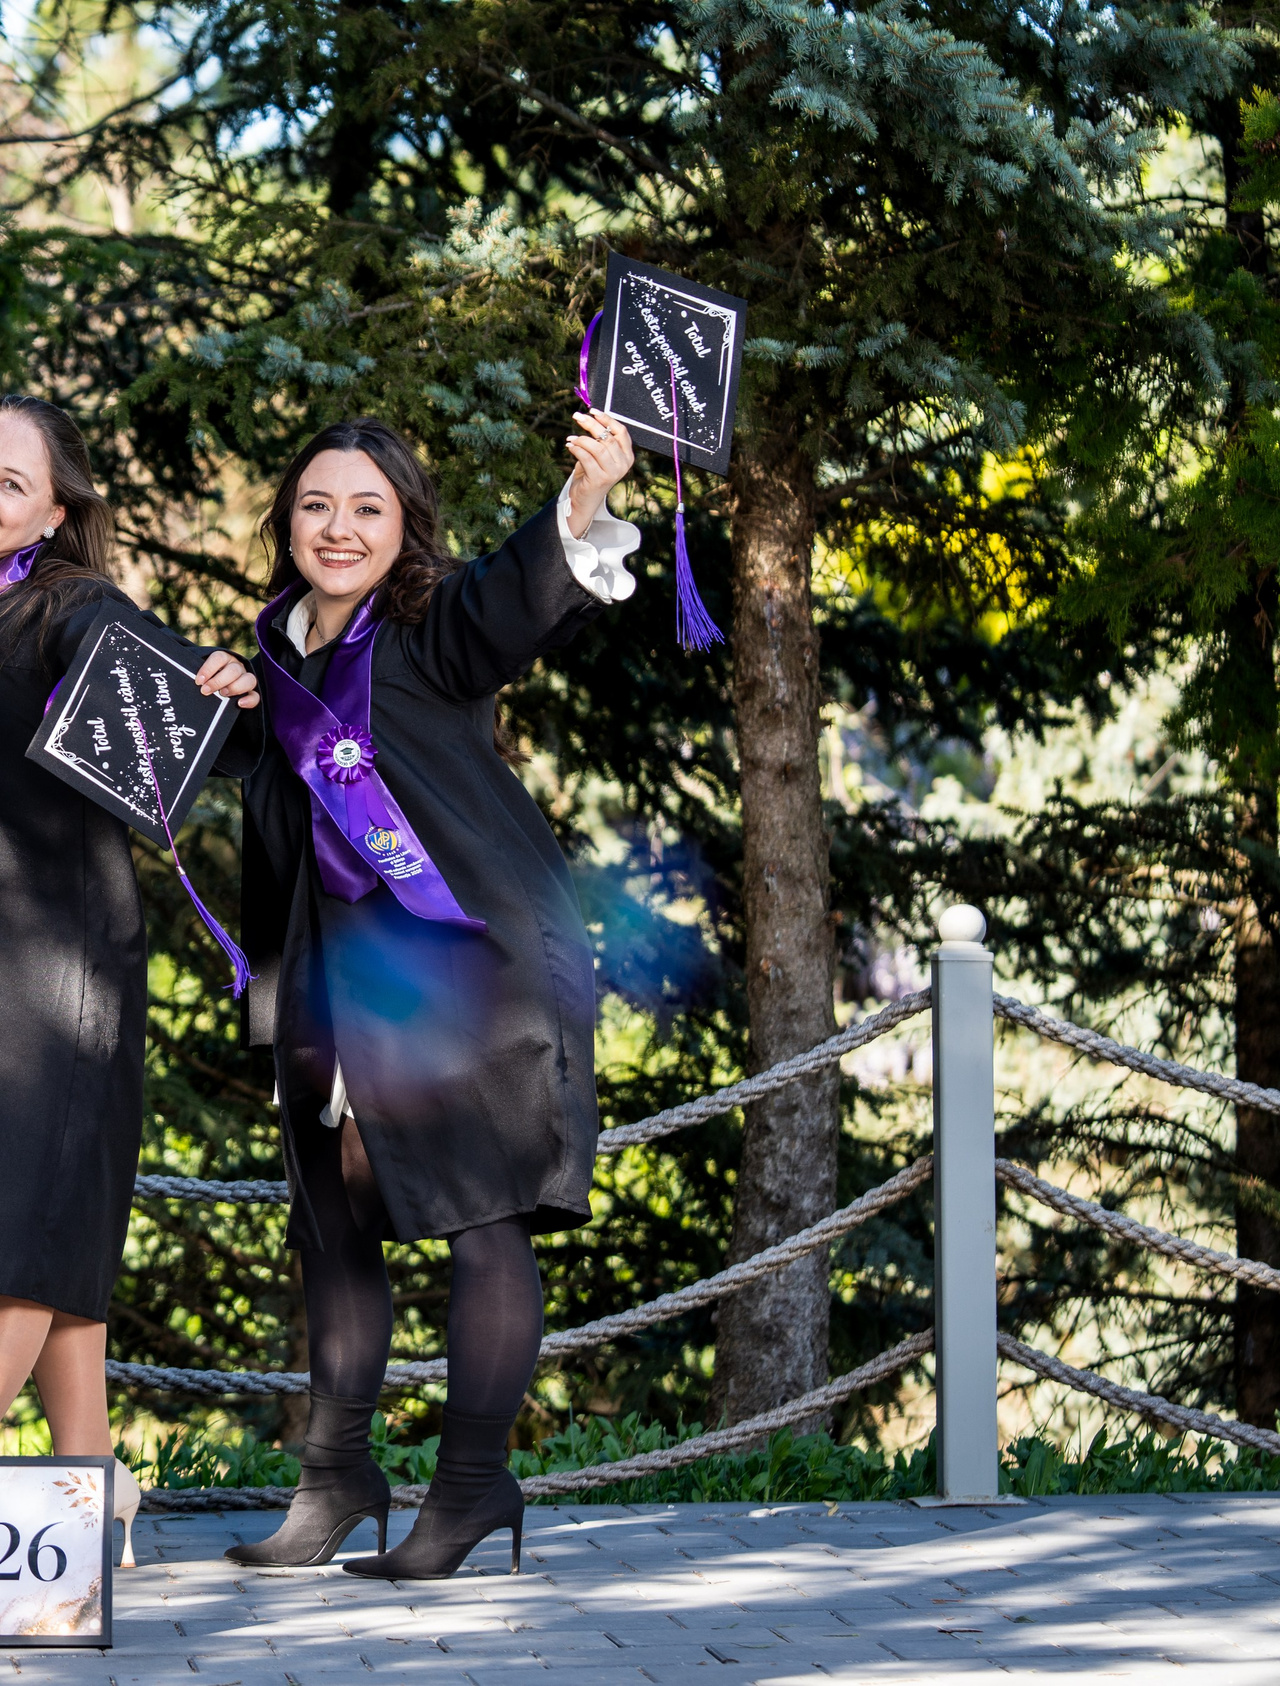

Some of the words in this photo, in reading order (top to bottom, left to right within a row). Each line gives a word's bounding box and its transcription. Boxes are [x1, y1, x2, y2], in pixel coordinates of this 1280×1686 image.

[684, 321, 711, 358] Totul
[641, 308, 660, 336] este
[680, 380, 707, 413] când
[622, 341, 650, 376] crezi
[650, 387, 674, 420] tine!
[110, 667, 134, 703] când
[150, 672, 172, 705] tine!
[87, 717, 111, 756] Totul
[120, 705, 156, 755] posibil
[164, 724, 197, 760] crezi
[137, 754, 155, 786] este
